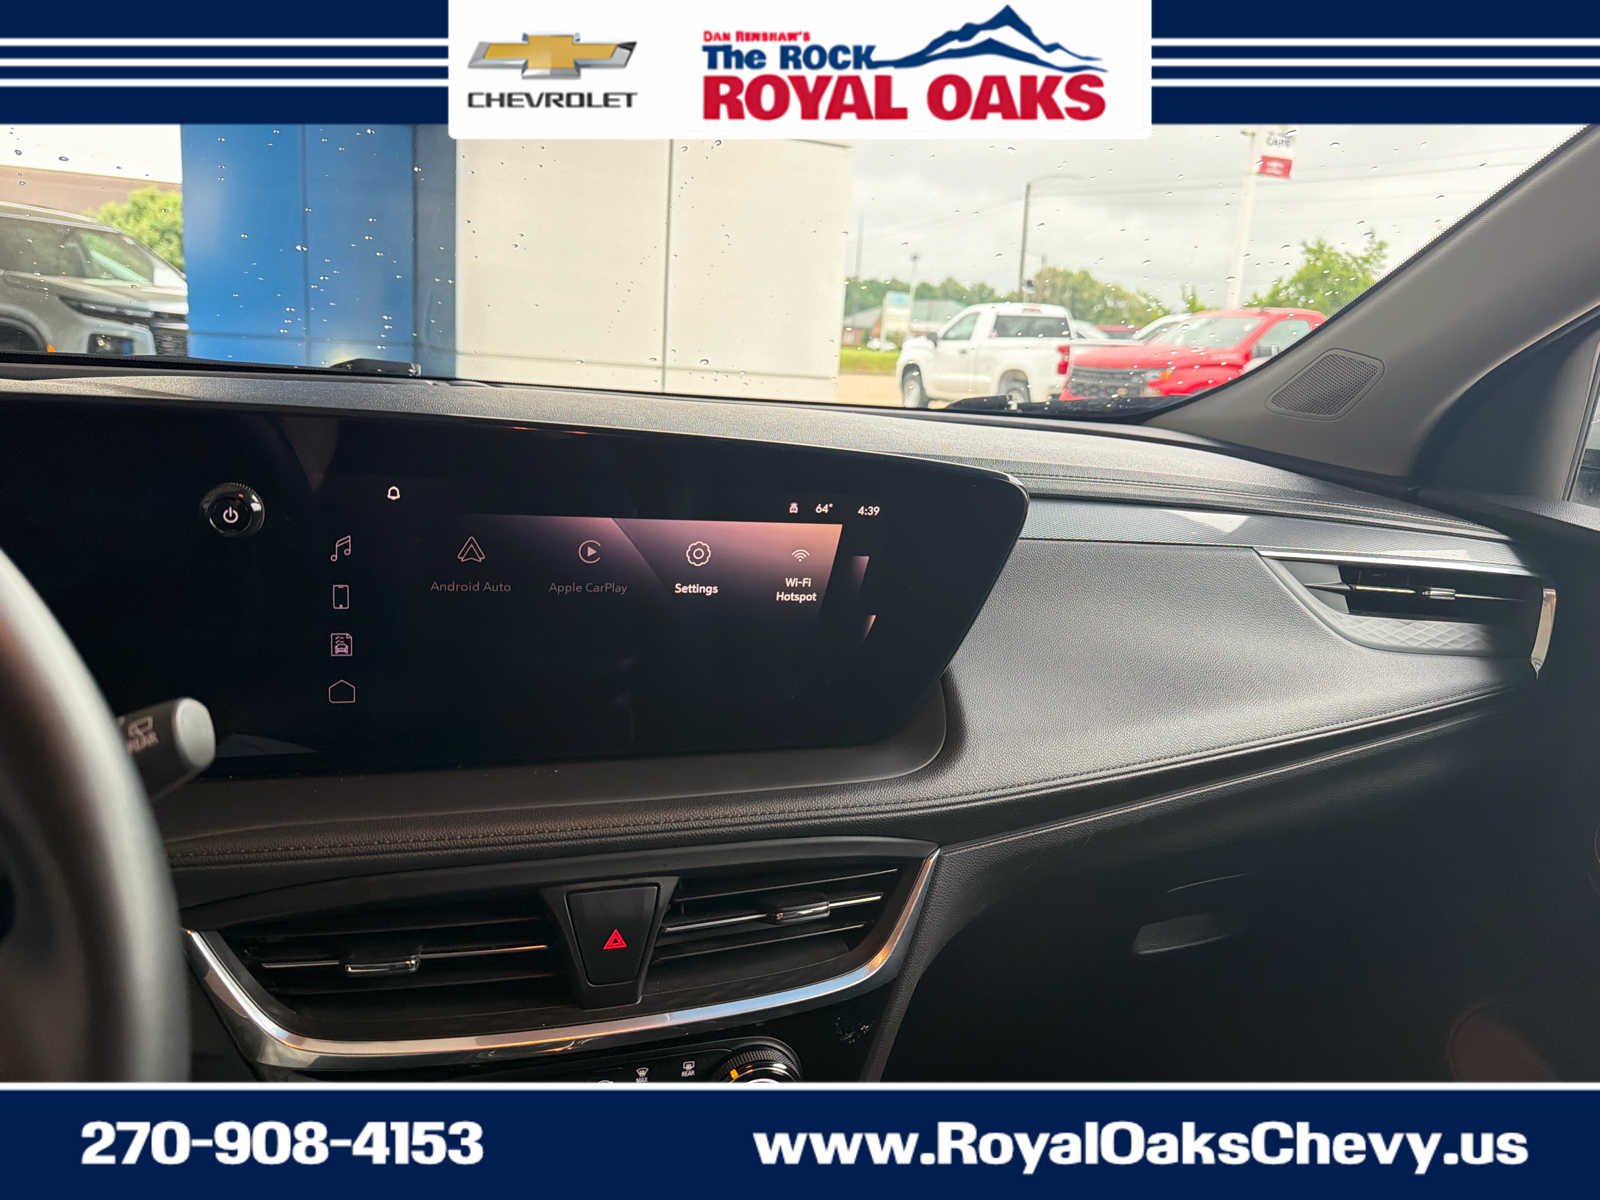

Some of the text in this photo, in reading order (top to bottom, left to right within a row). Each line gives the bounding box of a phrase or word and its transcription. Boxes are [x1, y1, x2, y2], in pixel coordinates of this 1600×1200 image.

[815, 503, 833, 514] 64°
[857, 505, 881, 516] 4:39
[430, 580, 512, 593] Android Auto
[549, 581, 628, 595] Apple CarPlay
[785, 576, 812, 588] Wi-Fi
[674, 582, 719, 597] Settings
[775, 590, 818, 604] Hotspot
